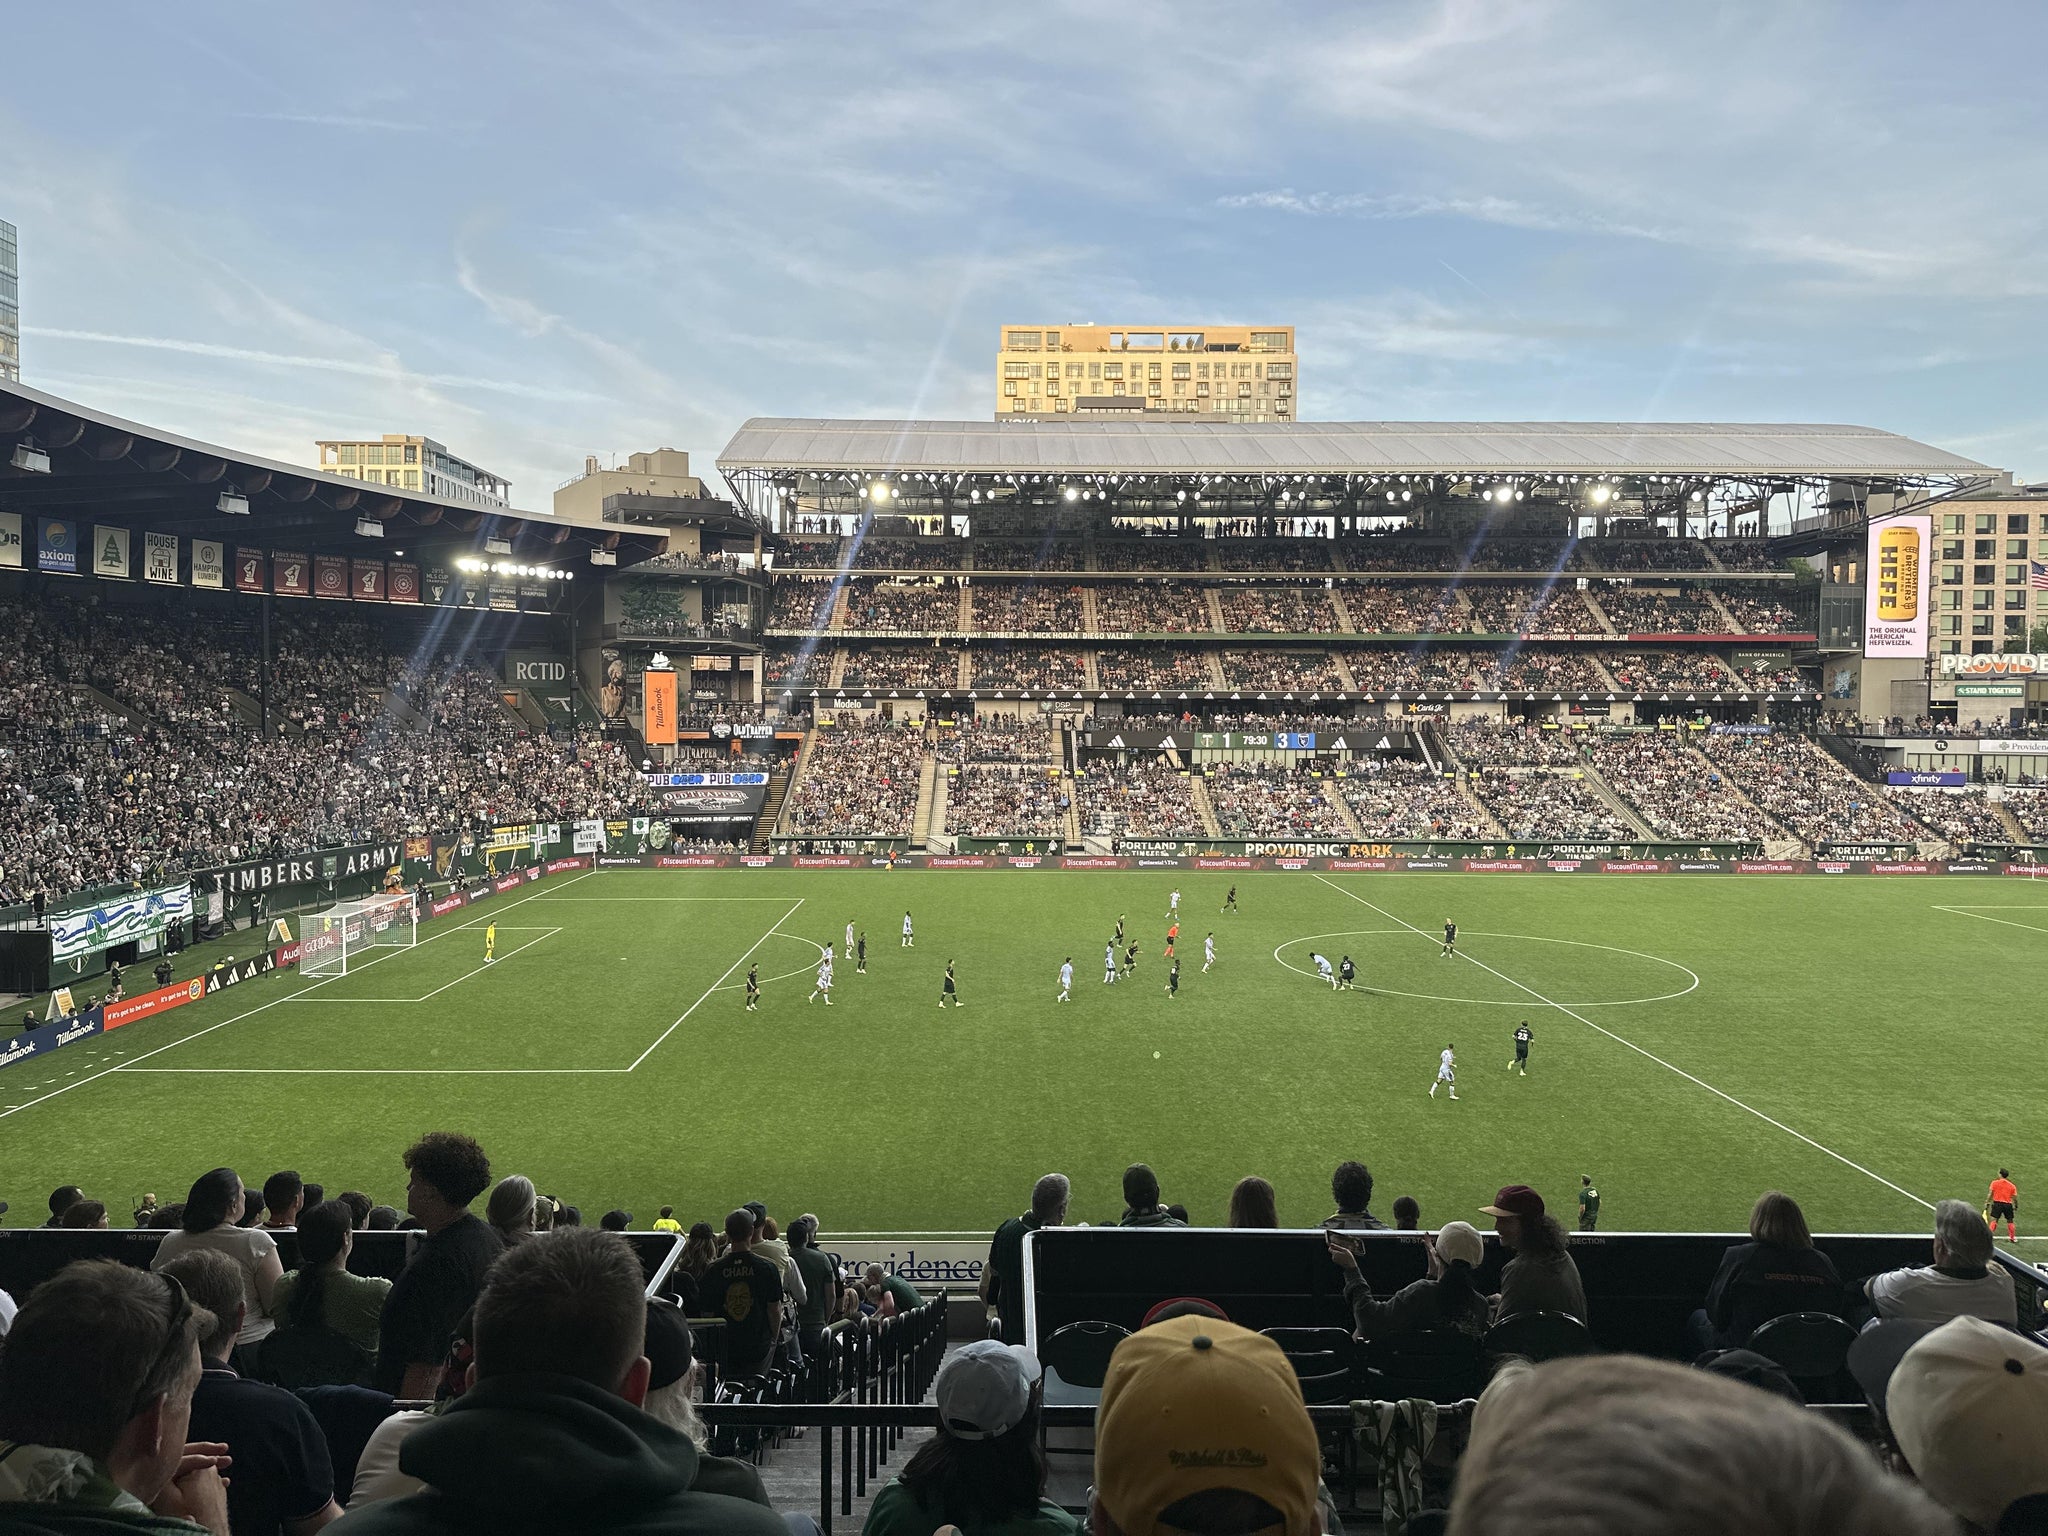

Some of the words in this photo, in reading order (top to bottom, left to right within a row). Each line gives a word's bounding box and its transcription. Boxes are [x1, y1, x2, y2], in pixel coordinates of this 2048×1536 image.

[147, 534, 176, 549] HOUSE
[39, 549, 75, 562] axiom
[205, 551, 211, 559] H
[149, 566, 173, 580] WINE
[193, 563, 222, 574] HAMPTON
[197, 572, 218, 581] LUMBER
[1880, 546, 1898, 609] HEFE
[1904, 555, 1912, 601] BROTHERS
[1940, 653, 2048, 674] PROVIDE
[516, 662, 565, 680] RCTID
[656, 687, 664, 729] Tillamook
[833, 699, 862, 709] Modelo
[1222, 733, 1230, 748] 1
[1242, 735, 1268, 745] 79:30
[1277, 733, 1288, 748] 3
[648, 774, 669, 785] PUB
[709, 774, 731, 785] PUB
[1911, 775, 1941, 784] xfinity
[1119, 841, 1177, 849] PORTLAND
[1350, 844, 1393, 857] PARK
[1553, 845, 1611, 853] PORTLAND
[663, 857, 715, 865] DiscountTire.com
[933, 858, 984, 866] DiscountTire.com
[1066, 858, 1117, 866] DiscountTire.com
[1200, 859, 1250, 867] DiscountTire.com
[1334, 861, 1386, 869] DiscountTire.com
[1470, 862, 1522, 870] DiscountTire.com
[213, 861, 314, 892] TIMBERS
[345, 846, 400, 876] ARMY
[1742, 864, 1793, 872] DiscountTire.com
[1876, 864, 1927, 872] DiscountTire.com
[282, 945, 301, 961] Audi
[112, 1011, 120, 1019] it's
[55, 1020, 95, 1047] Tillamook
[723, 1266, 754, 1278] CHARA
